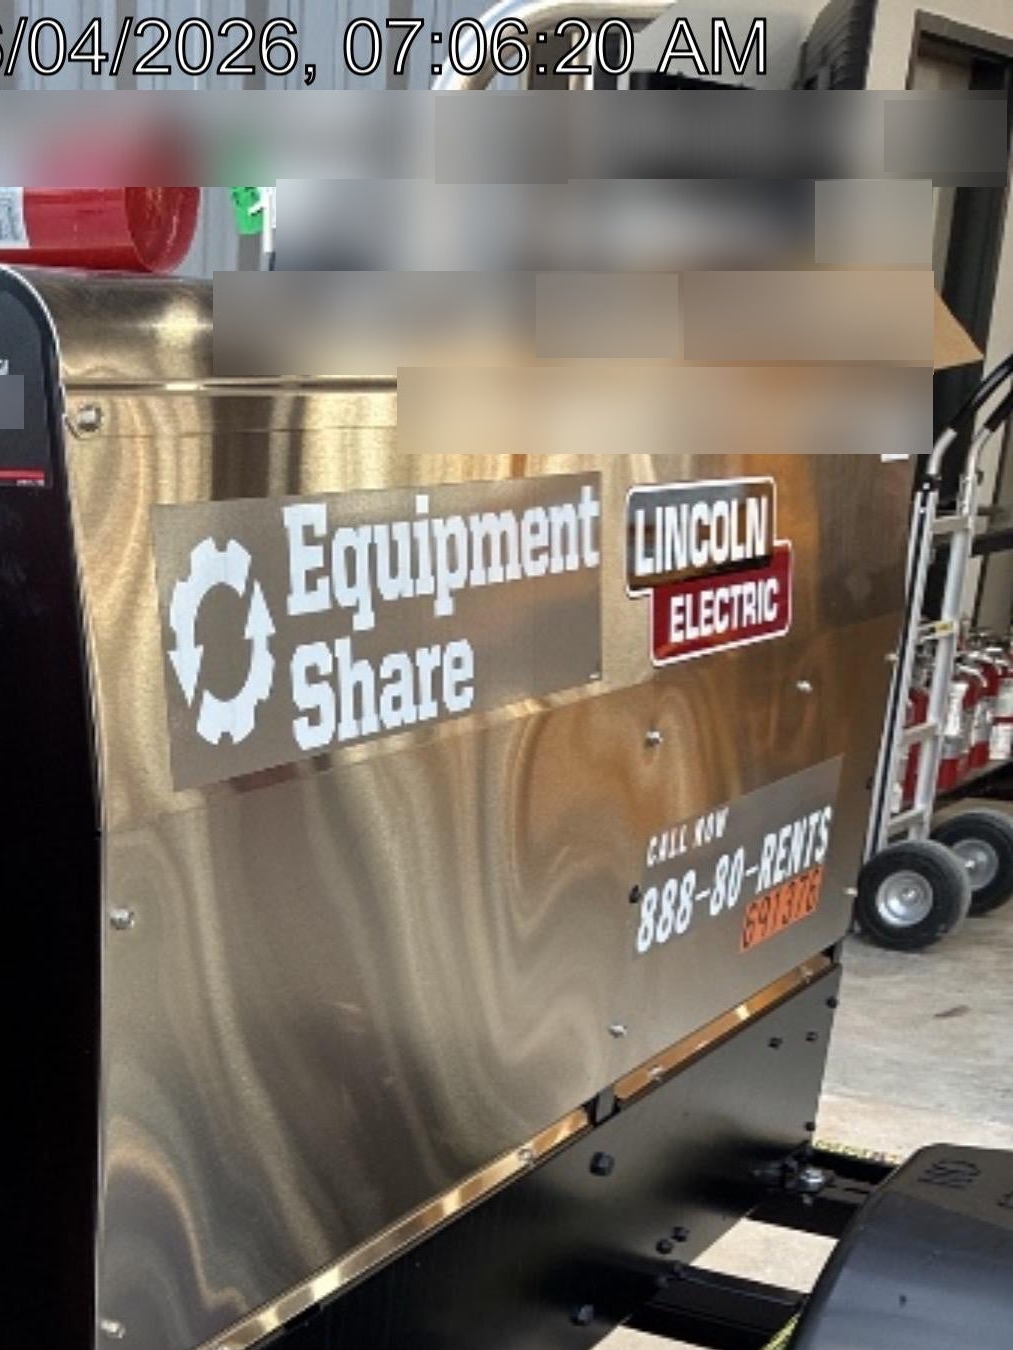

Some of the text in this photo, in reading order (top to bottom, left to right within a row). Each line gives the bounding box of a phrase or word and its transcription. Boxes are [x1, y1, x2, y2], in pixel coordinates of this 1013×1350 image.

[283, 485, 601, 631] Equipment
[634, 496, 769, 577] LINCOLN
[669, 577, 779, 643] ELECTRIC
[290, 637, 474, 752] Share
[637, 804, 832, 954] 888-80-RENTS
